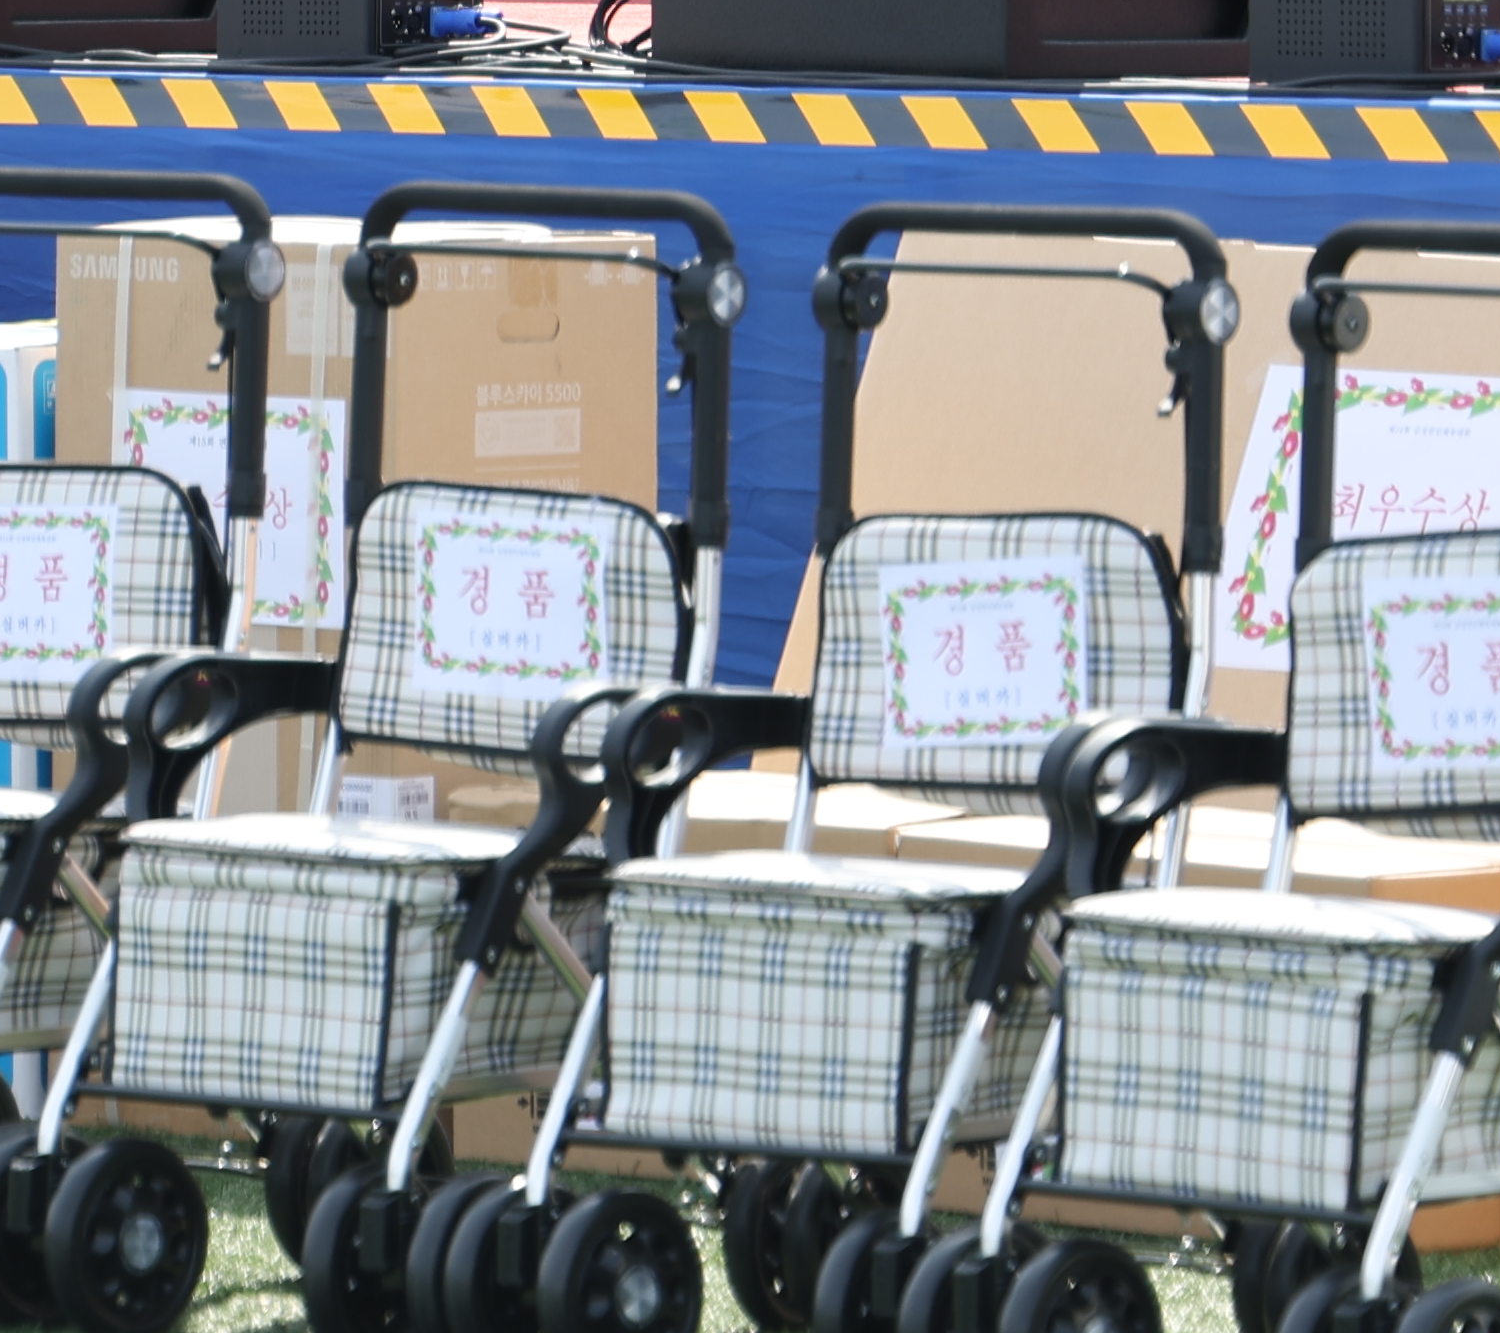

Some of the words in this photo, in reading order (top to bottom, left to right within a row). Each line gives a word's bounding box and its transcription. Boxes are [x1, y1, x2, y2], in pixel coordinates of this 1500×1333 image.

[70, 253, 180, 281] SAMUNG
[477, 383, 542, 407] 블루스카이
[545, 383, 581, 403] 5500
